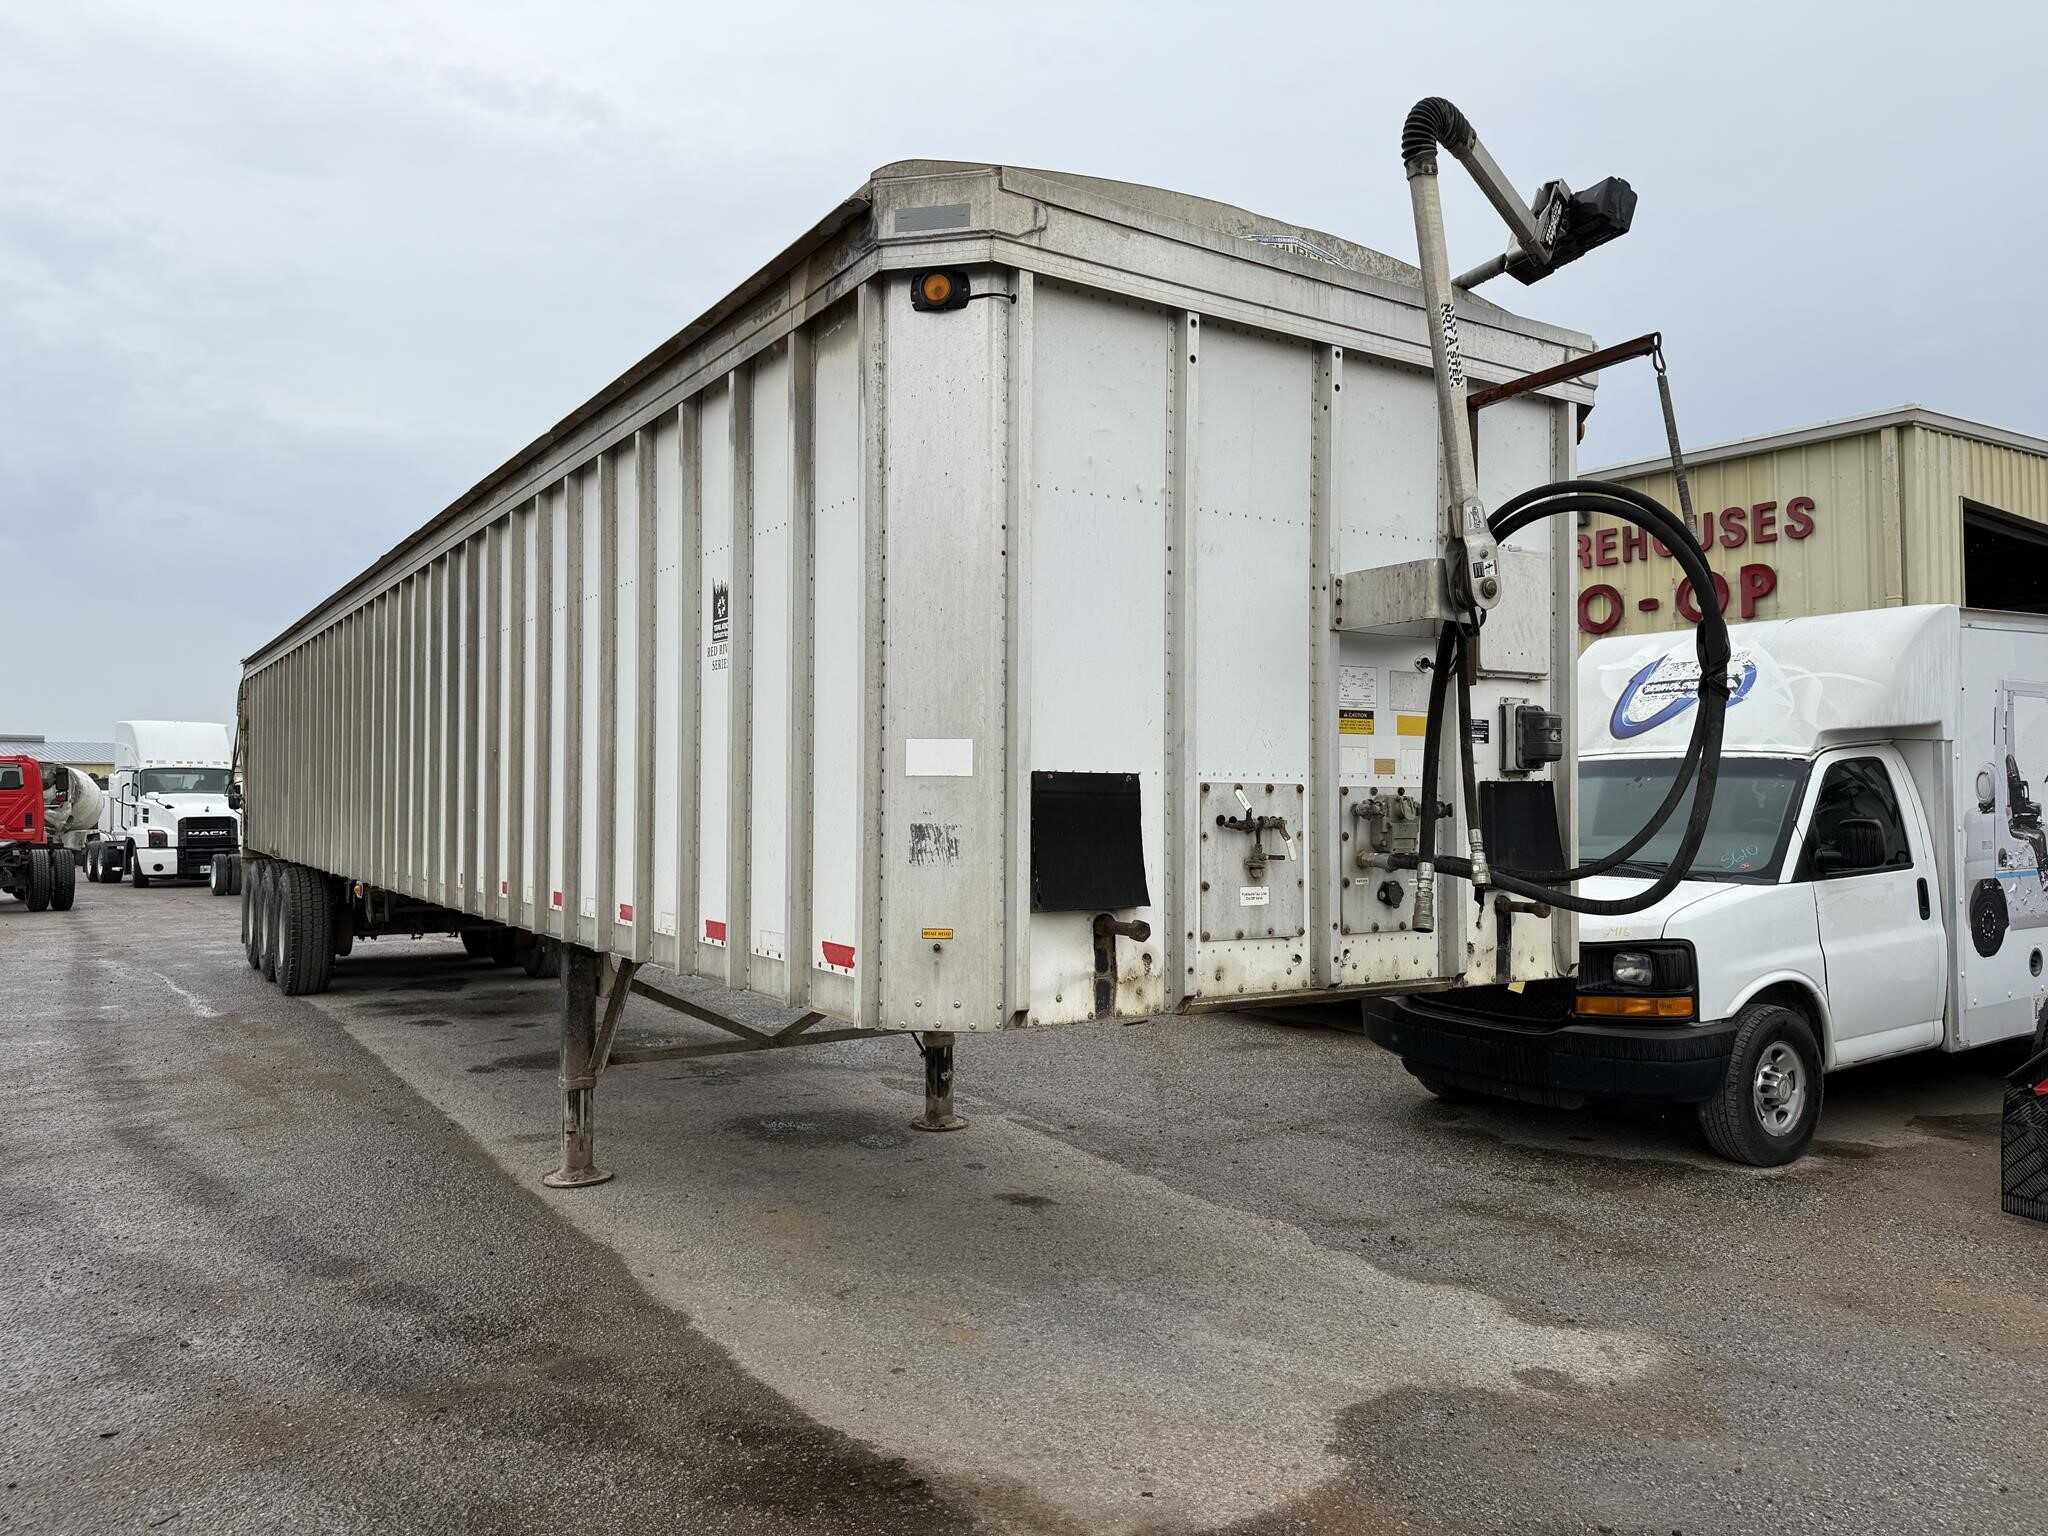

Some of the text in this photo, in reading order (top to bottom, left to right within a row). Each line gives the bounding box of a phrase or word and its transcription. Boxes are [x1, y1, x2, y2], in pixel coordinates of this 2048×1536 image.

[1443, 303, 1461, 386] NOT A STEP
[707, 645, 718, 657] RED
[712, 658, 728, 671] SERIE
